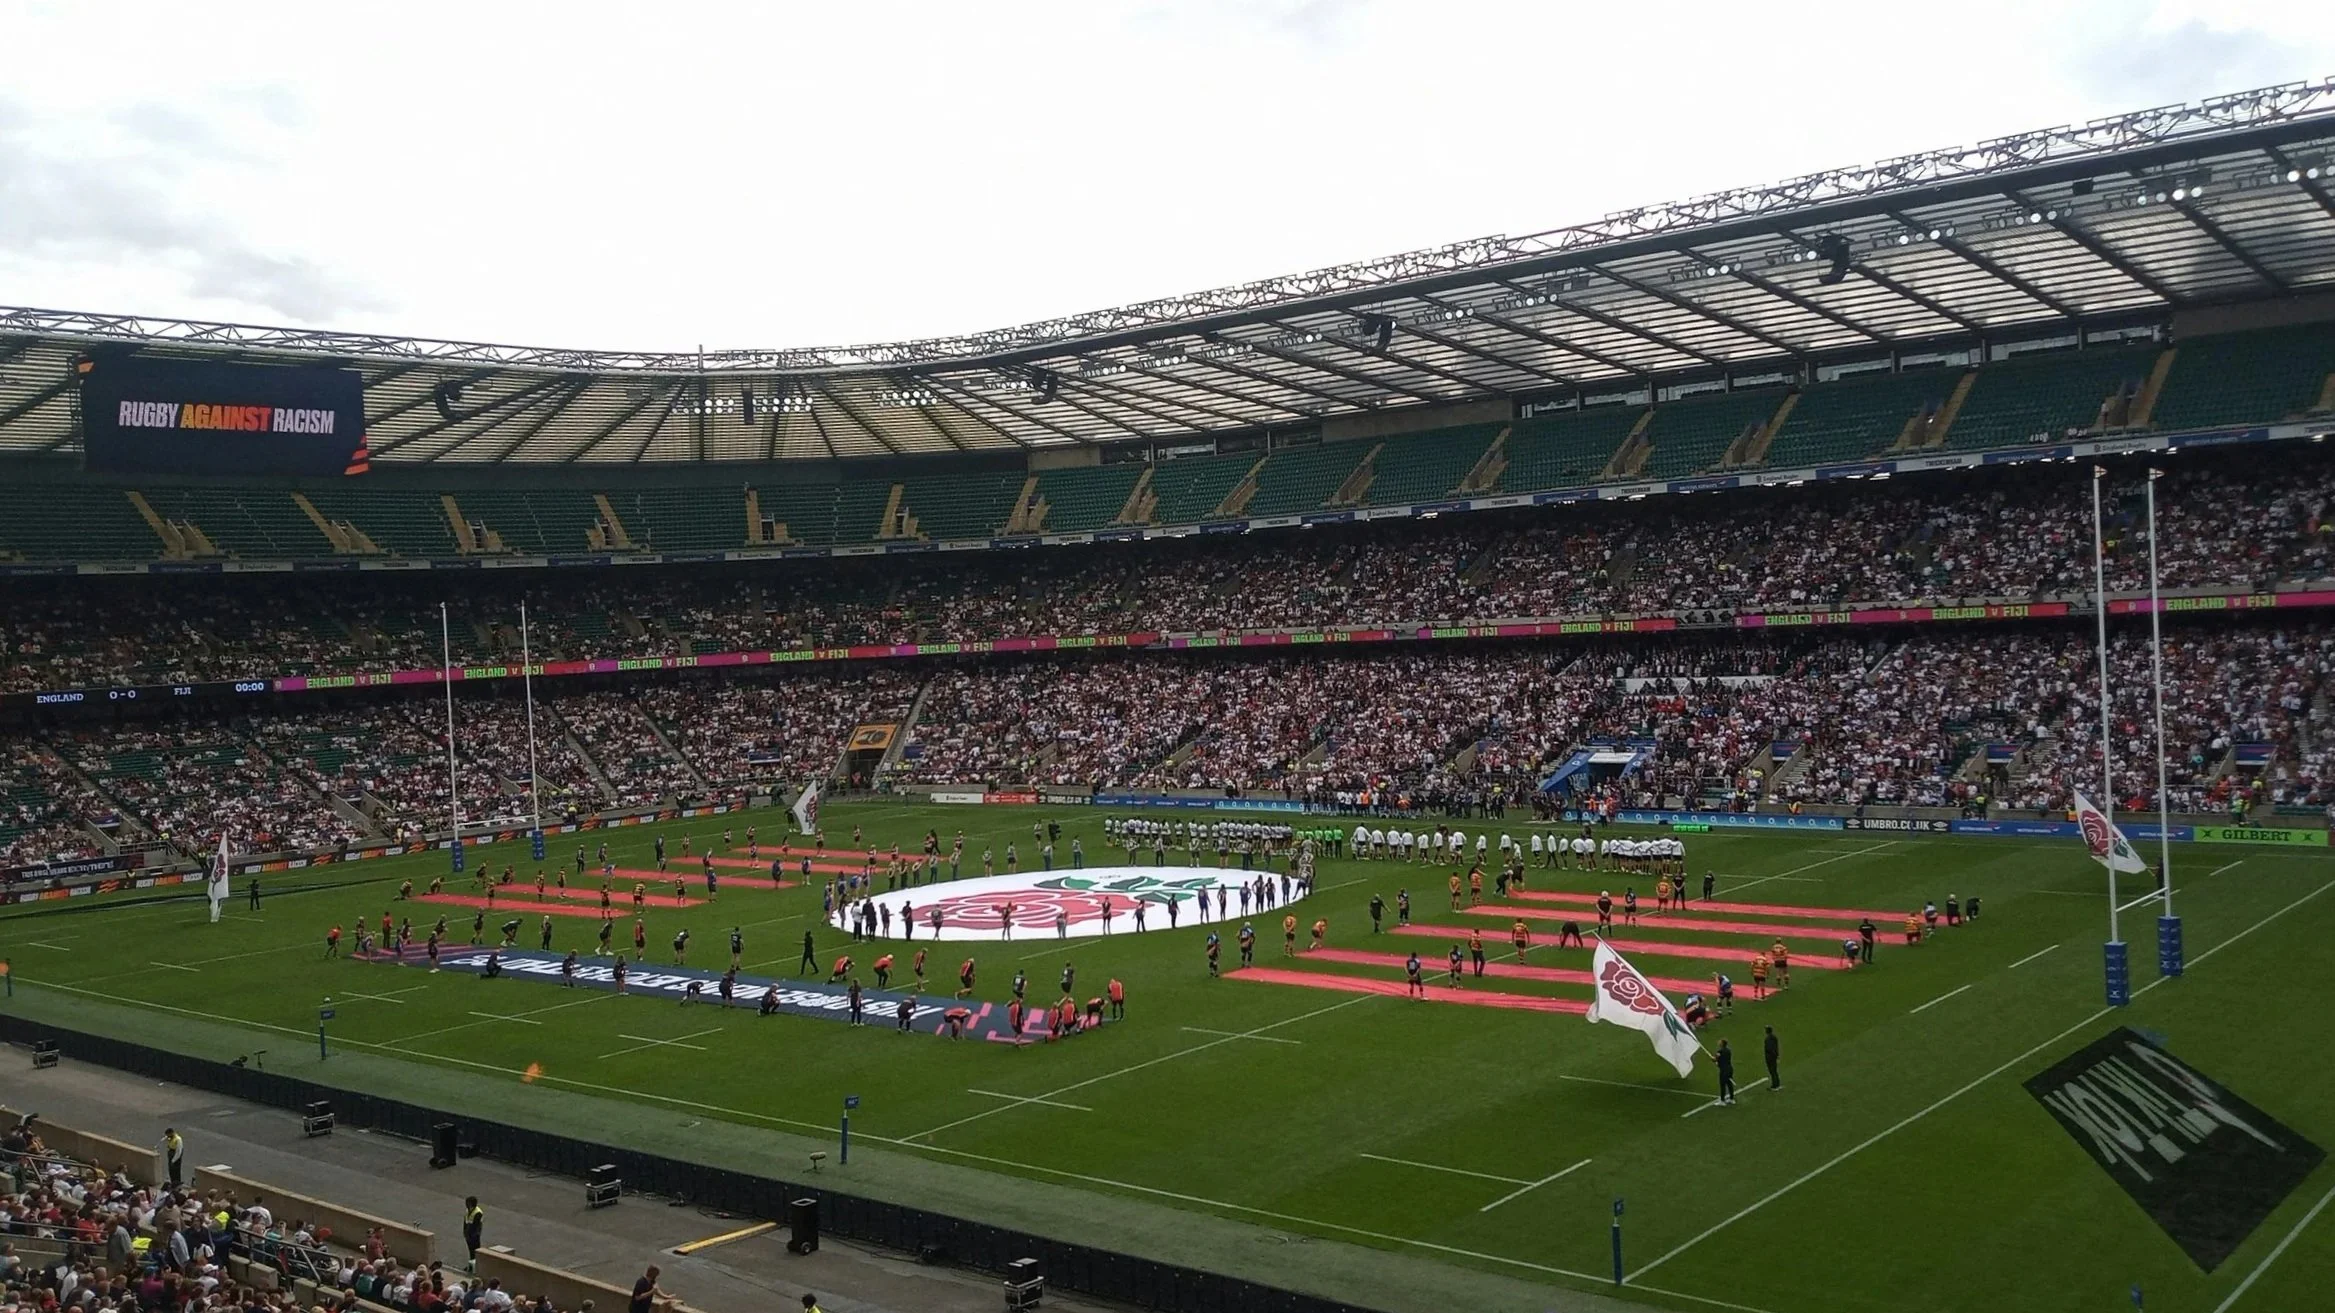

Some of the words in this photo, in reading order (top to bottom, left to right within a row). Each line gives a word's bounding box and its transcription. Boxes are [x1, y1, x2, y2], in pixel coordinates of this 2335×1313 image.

[119, 401, 179, 428] RUGBY
[180, 404, 273, 431] AGAINST
[273, 408, 335, 434] RACISM
[2166, 597, 2227, 611] ENGLAND
[2246, 595, 2277, 608] FIJI
[1932, 607, 1986, 619] ENGLAND
[2003, 604, 2028, 617] FIJI
[1765, 614, 1812, 625] ENGLAND
[1827, 613, 1850, 623] FIJI
[1431, 628, 1468, 638] ENGLAND
[1480, 626, 1498, 637] FIJI
[1560, 623, 1601, 633] ENGLAND
[1614, 621, 1634, 632] FIJI
[1056, 637, 1095, 647] ENGLAND
[1108, 636, 1127, 645] FIJI
[1187, 637, 1217, 647] ENGLAND
[1227, 636, 1241, 646] FIJI
[1291, 634, 1325, 644] ENGLAND
[1334, 632, 1350, 642] FIJI
[917, 643, 961, 654] ENGLAND
[974, 642, 993, 652] FIJI
[770, 651, 815, 662] ENGLAND
[828, 649, 849, 659] FIJI
[618, 659, 662, 670] ENGLAND
[676, 656, 698, 667] FIJI
[464, 667, 507, 678] ENGLAND
[306, 677, 355, 689] ENGLAND
[370, 674, 392, 685] FIJI
[37, 693, 83, 704] ENGLAND
[174, 687, 191, 696] FIJI
[235, 682, 264, 693] 00:00
[2222, 828, 2291, 842] GILBERT
